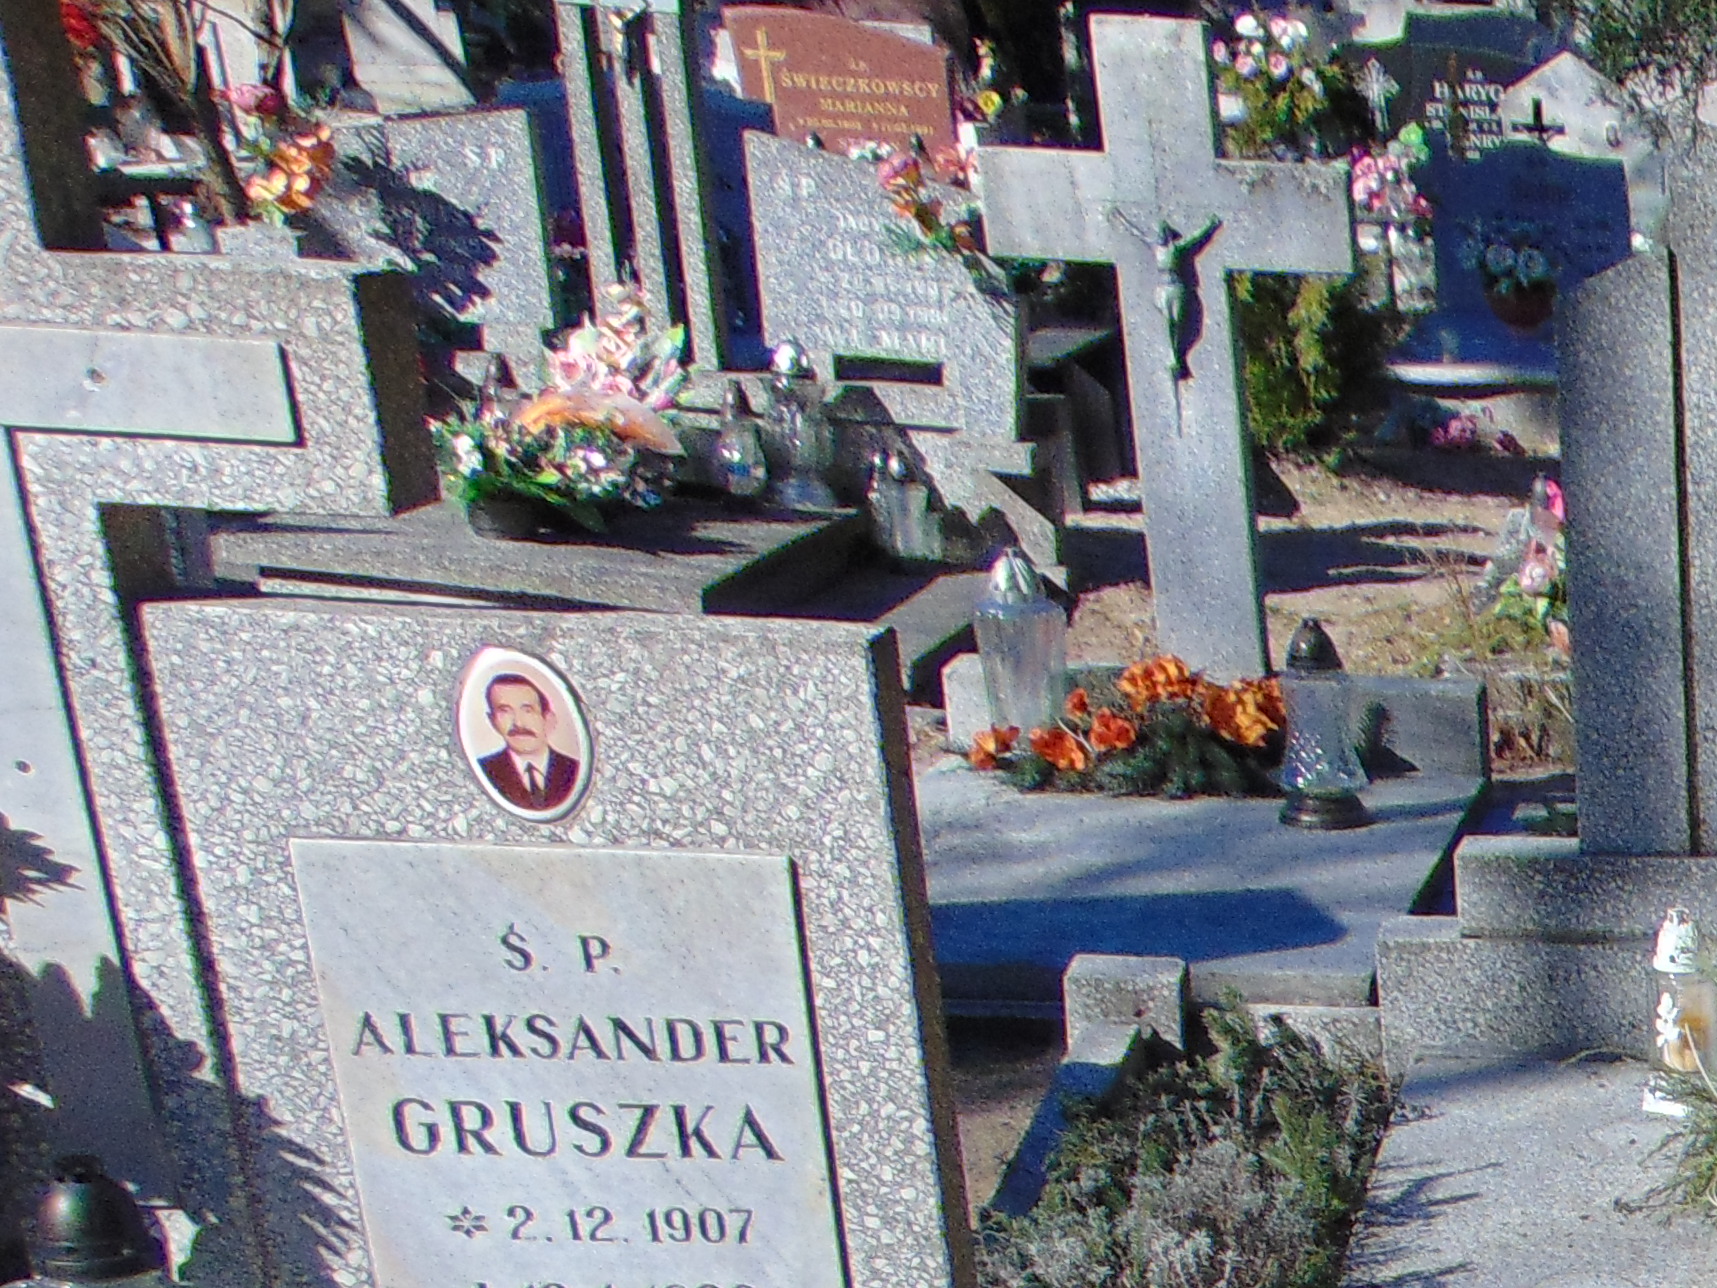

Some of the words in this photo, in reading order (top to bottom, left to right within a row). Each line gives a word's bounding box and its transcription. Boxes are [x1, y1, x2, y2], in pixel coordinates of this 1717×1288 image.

[819, 98, 909, 117] MARIANNA
[352, 1010, 796, 1065] ALEKSANDER
[391, 1098, 786, 1162] GRUSZKA
